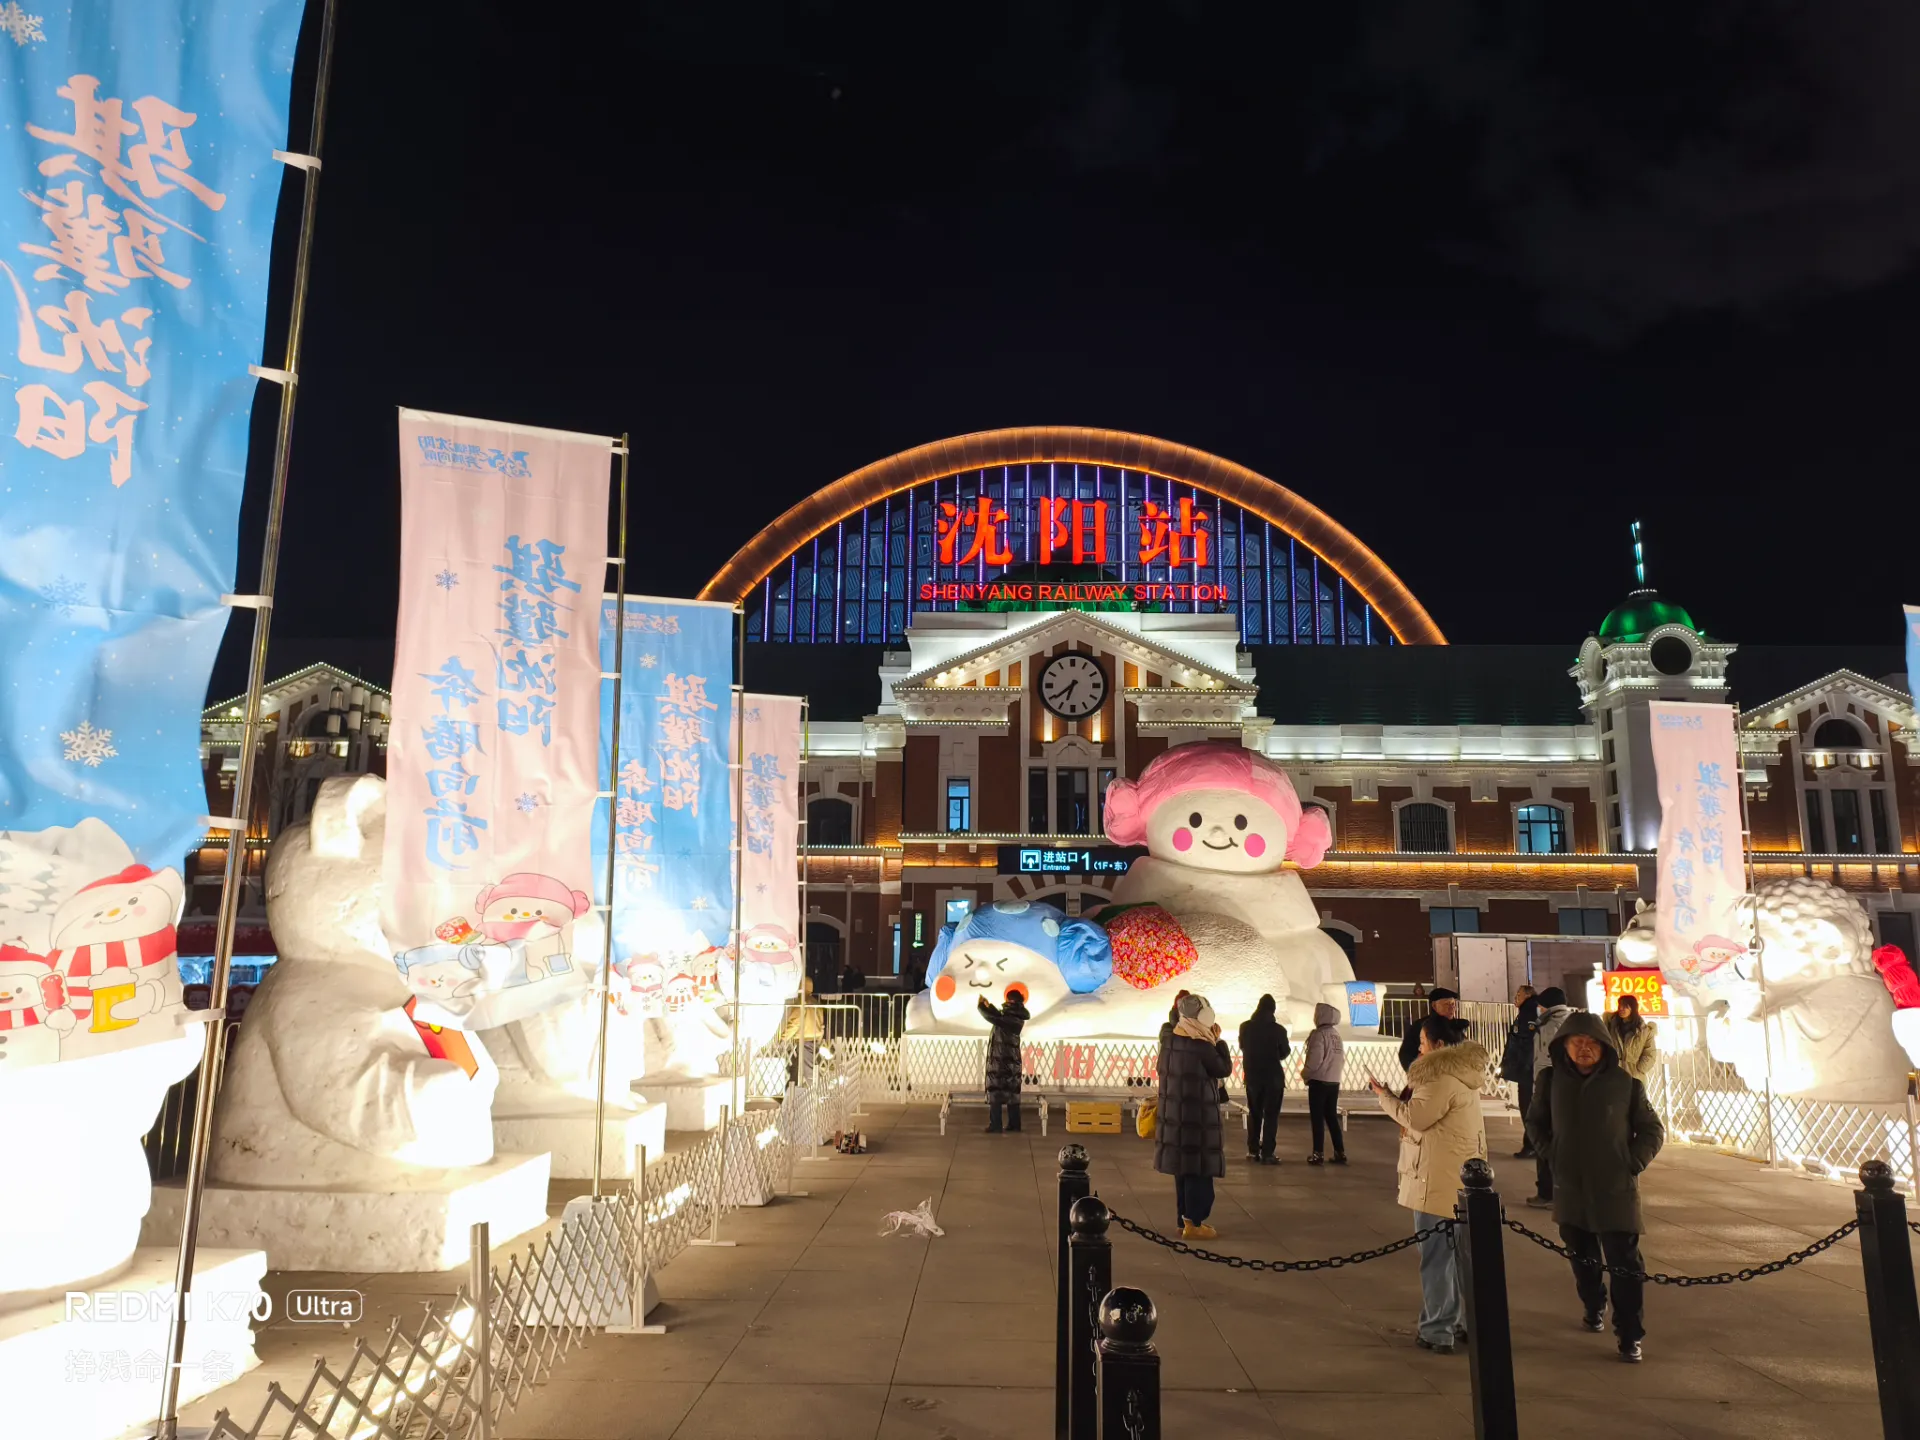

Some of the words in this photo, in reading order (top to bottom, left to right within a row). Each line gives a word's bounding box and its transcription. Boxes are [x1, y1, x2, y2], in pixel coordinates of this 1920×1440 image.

[937, 495, 1209, 567] 沈阳站
[920, 584, 1032, 600] SHENYANG
[1039, 584, 1127, 600] RAILWAY
[1134, 584, 1228, 601] STATION
[1043, 851, 1078, 864] 进站口
[1081, 852, 1090, 871] 1
[1610, 976, 1659, 993] 2026
